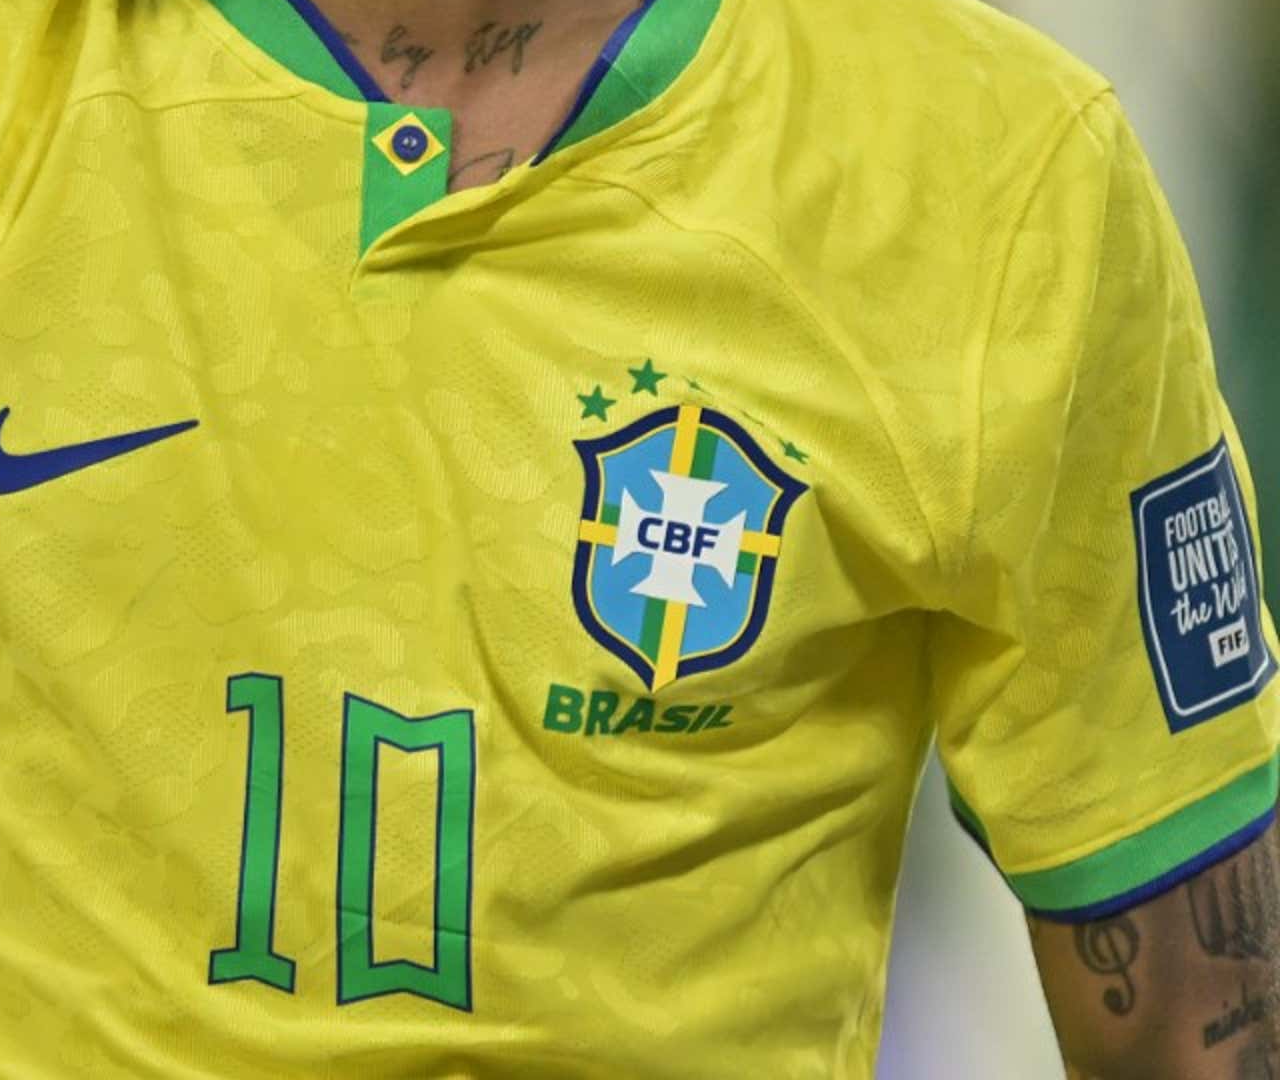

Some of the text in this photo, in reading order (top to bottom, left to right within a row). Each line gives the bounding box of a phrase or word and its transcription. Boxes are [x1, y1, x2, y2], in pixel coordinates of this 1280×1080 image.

[636, 516, 720, 559] CBF
[1170, 591, 1213, 636] the
[542, 682, 735, 738] BRASIL
[207, 670, 477, 1013] 10
